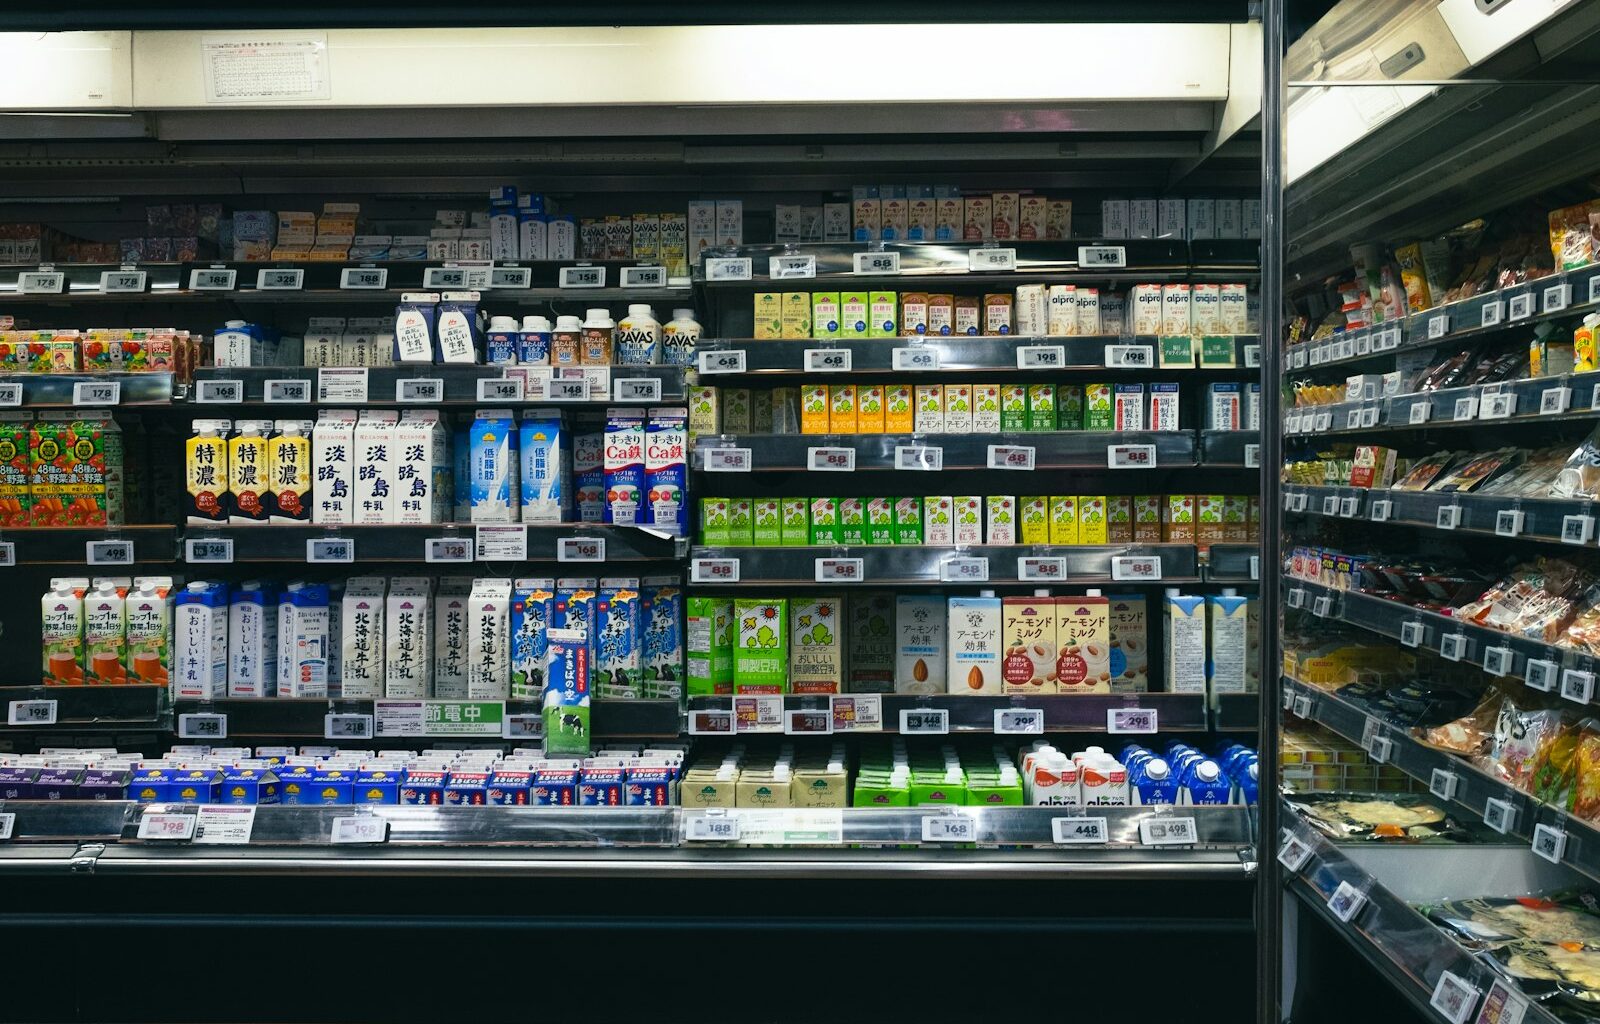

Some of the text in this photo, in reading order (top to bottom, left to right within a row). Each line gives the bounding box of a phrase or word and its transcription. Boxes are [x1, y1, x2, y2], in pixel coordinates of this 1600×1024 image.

[989, 255, 1008, 263] 88
[1098, 252, 1118, 260] 148
[873, 259, 892, 267] 88
[725, 265, 744, 273] 128
[119, 277, 138, 285] 178
[209, 276, 228, 284] 188
[276, 275, 295, 283] 328
[579, 273, 598, 281] 158
[1052, 294, 1075, 306] alpro
[1076, 297, 1097, 308] alpro
[1139, 294, 1160, 304] alpro
[1166, 294, 1189, 304] alpro
[1102, 301, 1123, 312] alpro
[620, 331, 653, 344] SAVAS
[664, 335, 696, 347] SAVAS
[823, 356, 843, 364] 68
[912, 355, 932, 363] 68
[1036, 353, 1057, 361] 198
[1126, 352, 1145, 360] 198
[719, 356, 738, 366] 68
[92, 389, 112, 398] 178
[215, 387, 235, 396] 168
[284, 387, 303, 396] 128
[416, 386, 435, 394] 158
[497, 385, 516, 394] 148
[562, 385, 582, 394] 148
[633, 385, 653, 394] 178
[918, 420, 942, 428] アーモンド
[946, 420, 971, 428] アーモンド
[974, 420, 1000, 428] アーモンド
[1005, 420, 1023, 428] 抹茶
[1033, 420, 1051, 428] 抹茶
[1090, 418, 1108, 427] 抹茶
[609, 434, 641, 445] すっきり
[650, 434, 682, 445] すっきり
[606, 445, 642, 460] Ca鉄
[648, 445, 684, 460] Ca鉄
[1128, 452, 1148, 460] 88
[724, 455, 743, 464] 88
[827, 455, 847, 464] 88
[1008, 454, 1026, 462] 88
[196, 444, 216, 486] 特濃
[238, 444, 258, 486] 特濃
[278, 443, 298, 486] 特濃
[484, 448, 495, 480] 低脂肪
[534, 447, 546, 480] 低脂肪
[38, 464, 62, 474] 48種の
[72, 464, 97, 474] 48種の
[318, 444, 348, 498] 淡路島
[359, 444, 390, 498] 淡路島
[398, 444, 428, 498] 淡路島
[33, 474, 68, 484] 濃い野菜
[69, 474, 103, 484] 濃い野菜
[322, 500, 343, 511] 牛乳
[363, 500, 384, 511] 牛乳
[402, 500, 422, 511] 牛乳
[930, 532, 948, 541] 紅茶
[960, 532, 977, 541] 紅茶
[992, 532, 1010, 541] 紅茶
[106, 549, 126, 557] 498
[326, 547, 346, 555] 248
[444, 546, 464, 554] 128
[577, 546, 597, 554] 168
[712, 566, 731, 574] 88
[836, 566, 855, 574] 88
[960, 565, 980, 574] 88
[1039, 564, 1058, 573] 88
[1132, 564, 1152, 573] 88
[1110, 612, 1144, 622] ーモンド
[1008, 617, 1052, 628] アーモンド
[1062, 617, 1106, 628] アーモンド
[657, 606, 671, 660] 北のおいしさ
[904, 625, 940, 634] アーモンド
[1016, 628, 1043, 639] ミルク
[1070, 628, 1096, 639] ミルク
[529, 608, 542, 664] 北のおいしさ
[614, 608, 628, 664] 北のおいしさ
[956, 630, 996, 640] アーモンド
[447, 611, 462, 677] 北海道牛乳
[604, 624, 616, 666] まる搾り
[910, 635, 932, 646] 効果
[187, 615, 199, 681] おいしい牛乳
[240, 613, 251, 678] おいしい牛乳
[283, 615, 291, 679] おいしい牛乳
[355, 612, 370, 680] 北海道牛乳
[400, 612, 414, 680] 北海道牛乳
[481, 614, 496, 683] 北海道牛乳
[964, 640, 988, 652] 効果
[798, 654, 832, 664] おいしい
[738, 658, 782, 673] 調製豆乳
[793, 664, 837, 676] 無調整豆乳
[564, 649, 575, 700] まきばの空
[28, 708, 48, 716] 198
[425, 704, 481, 722] 節電中
[709, 718, 730, 728] 218
[805, 718, 826, 728] 218
[1128, 717, 1149, 725] 298
[200, 722, 218, 730] 258
[345, 722, 364, 731] 218
[523, 723, 542, 731] 178
[162, 822, 184, 831] 198
[355, 825, 376, 834] 198
[709, 824, 731, 832] 188
[944, 824, 967, 833] 168
[1076, 826, 1098, 834] 448
[1168, 824, 1186, 833] 498
